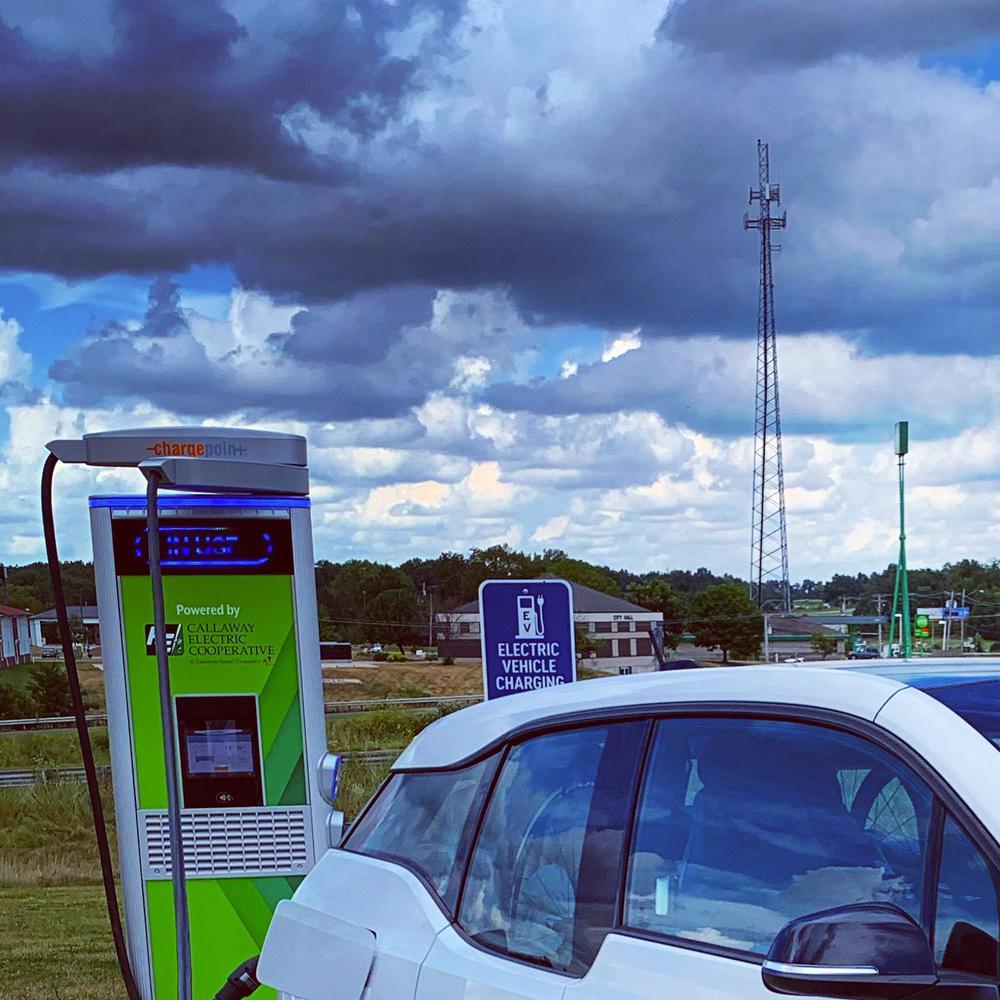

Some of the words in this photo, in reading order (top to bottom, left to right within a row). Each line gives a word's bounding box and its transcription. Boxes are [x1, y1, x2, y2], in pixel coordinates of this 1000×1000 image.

[176, 605, 224, 616] Powered
[227, 605, 240, 618] by
[187, 623, 256, 633] CALLAWAY
[188, 634, 247, 645] ELECTRIC
[188, 645, 275, 656] COOPERATIVE
[498, 643, 560, 656] ELECTRIC
[502, 659, 557, 673] VEHICLE
[496, 676, 564, 690] CHARGING
